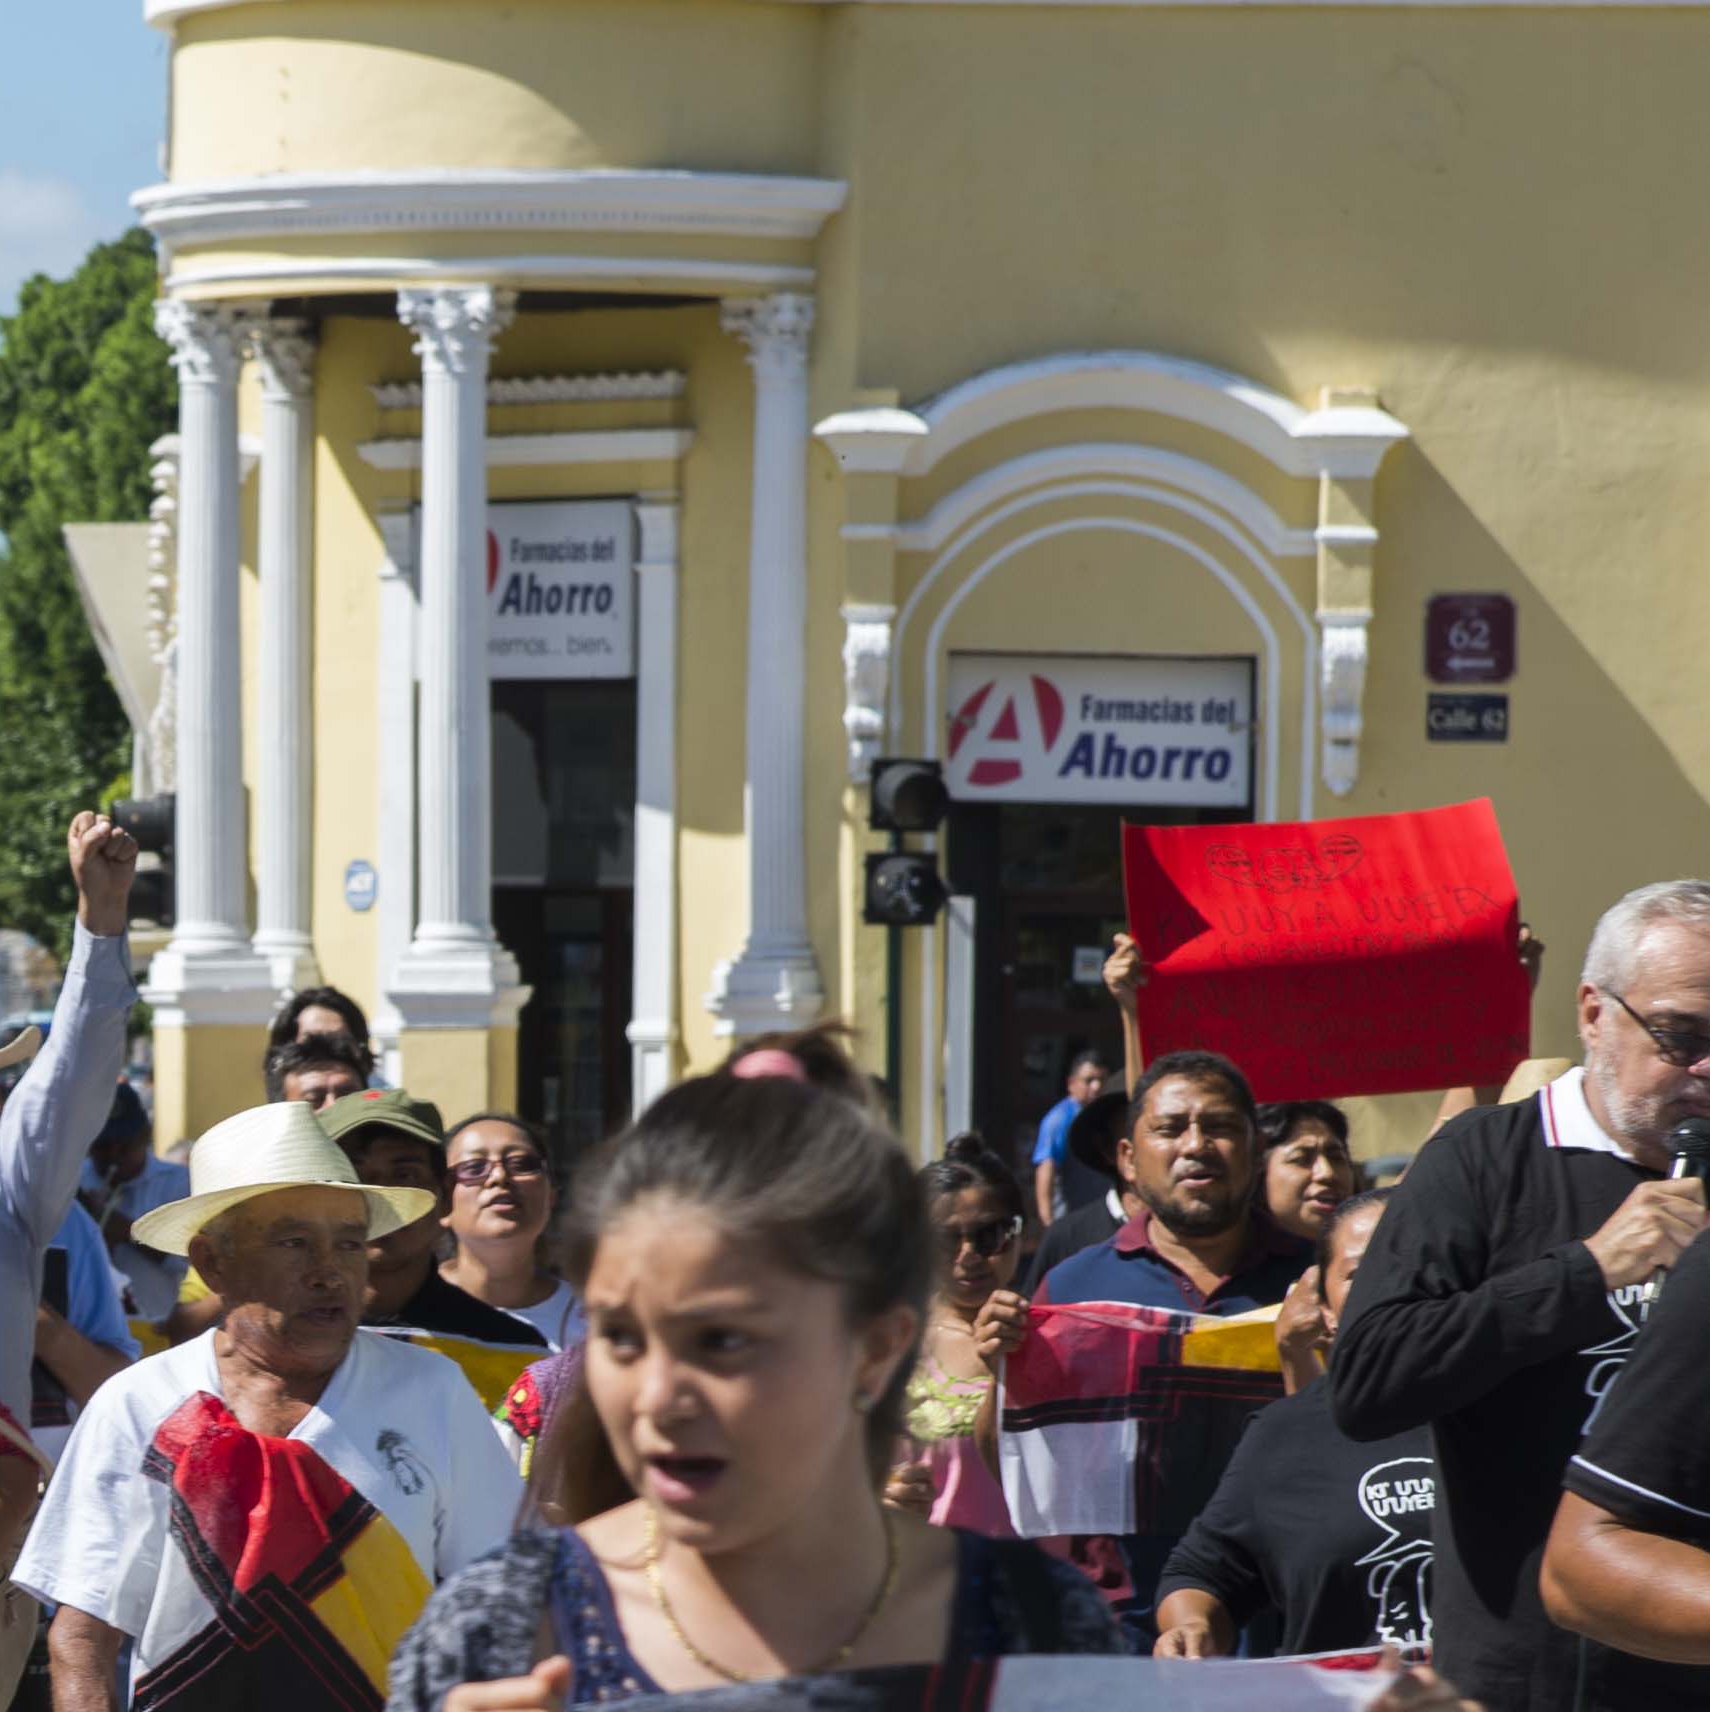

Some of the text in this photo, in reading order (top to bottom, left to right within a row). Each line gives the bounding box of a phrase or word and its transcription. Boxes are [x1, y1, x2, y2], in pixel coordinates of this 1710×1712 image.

[510, 535, 615, 563] Farmacias del
[497, 571, 614, 616] Ahorro
[1448, 618, 1491, 650] 62
[1080, 694, 1194, 723] Farmacias
[1201, 698, 1235, 724] del
[1430, 708, 1477, 731] Calle
[1057, 730, 1233, 782] Ahorro
